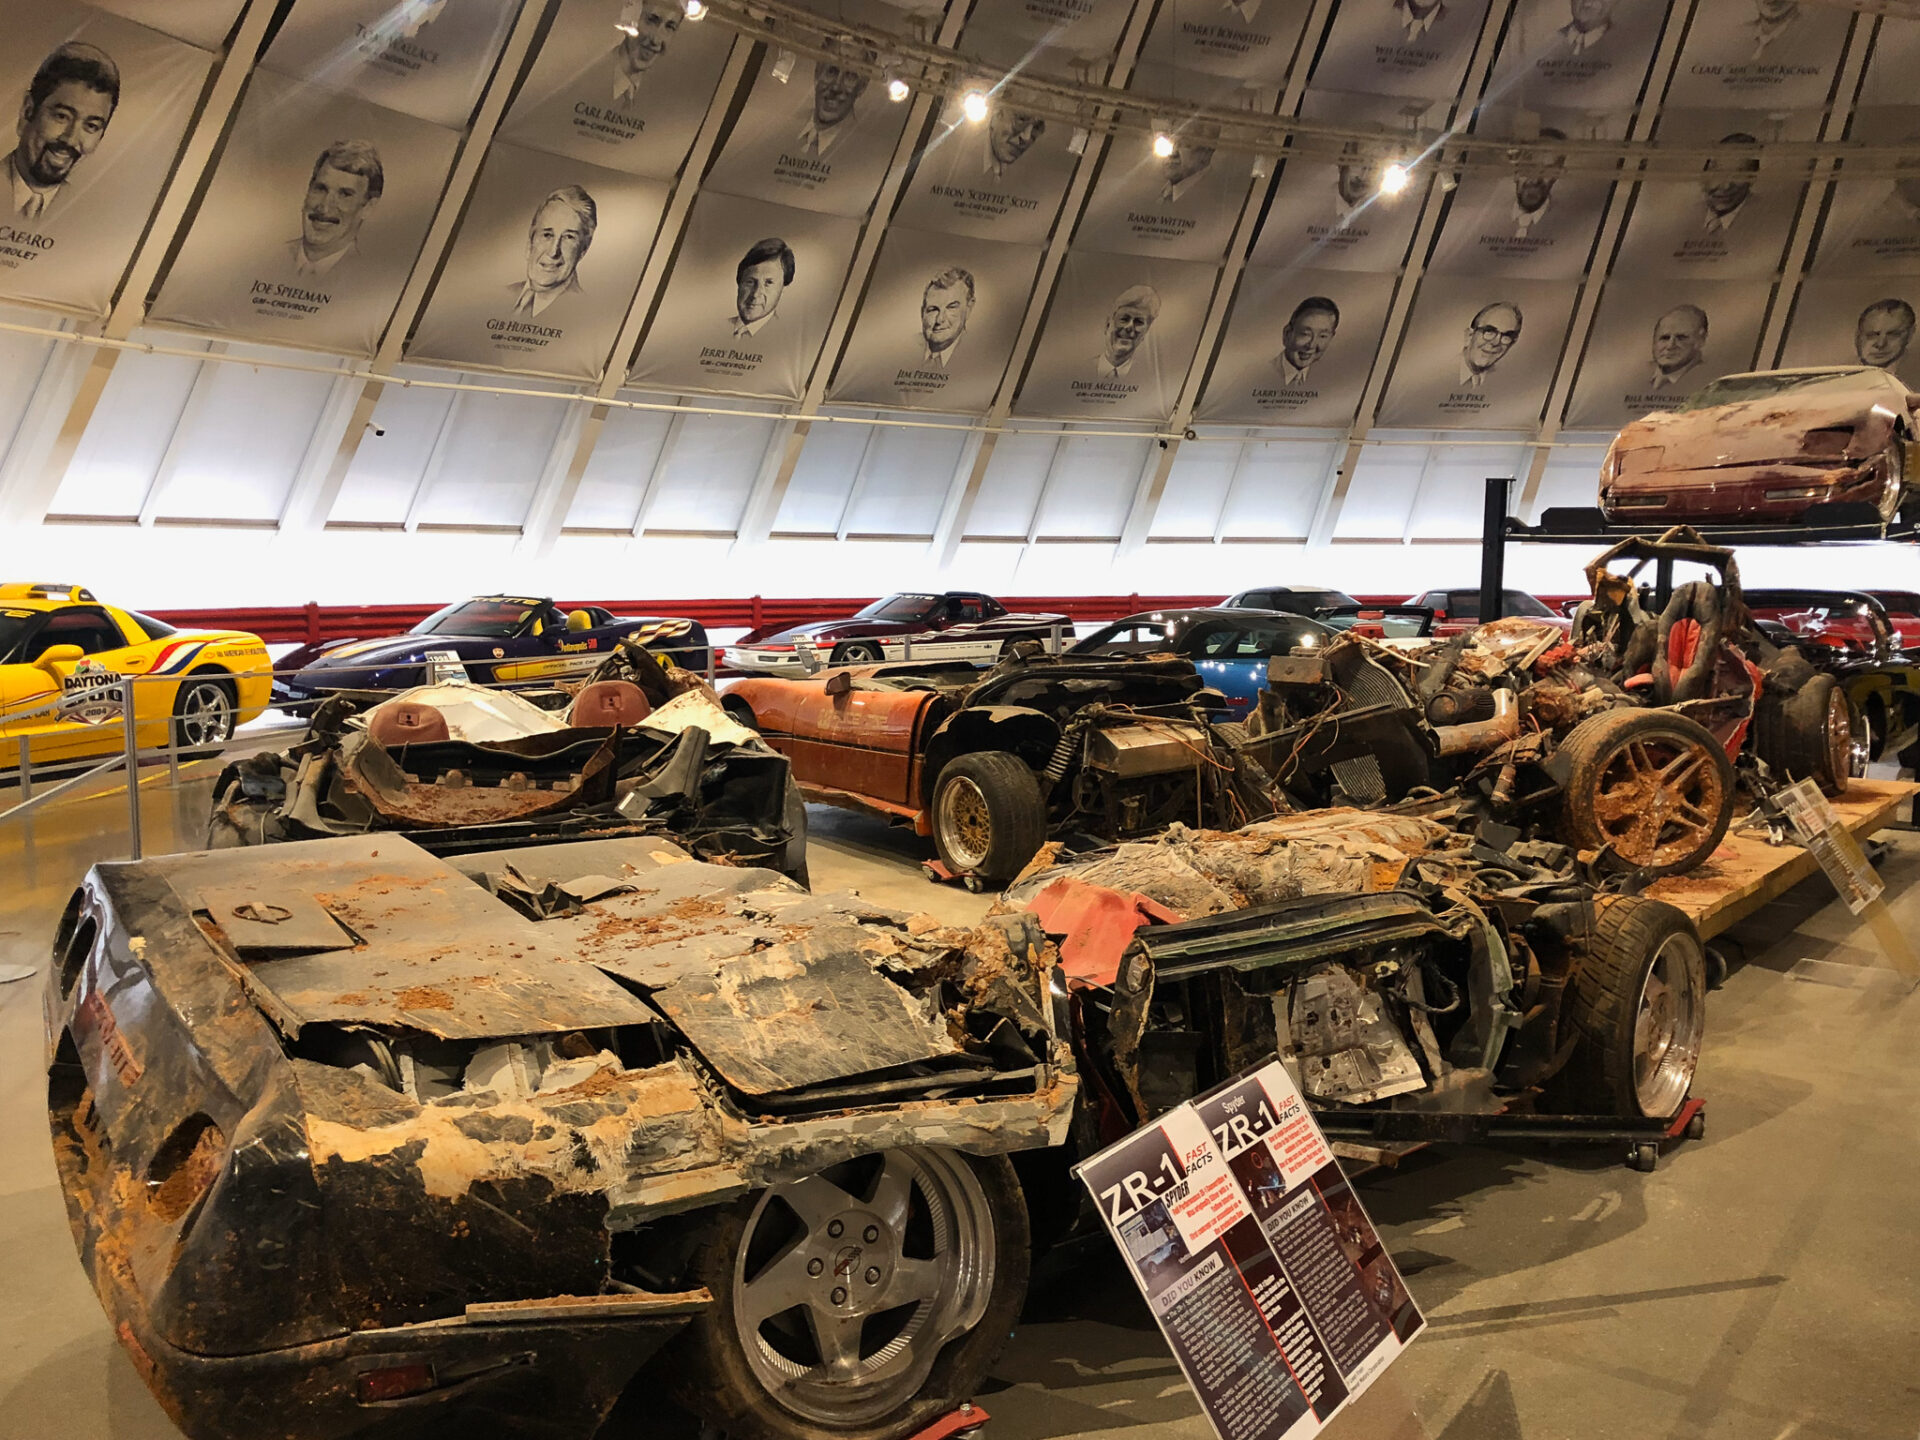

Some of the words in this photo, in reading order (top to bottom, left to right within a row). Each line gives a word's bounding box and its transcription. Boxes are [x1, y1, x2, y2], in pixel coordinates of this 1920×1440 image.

[574, 101, 601, 119] CARL
[0, 225, 55, 250] CAFARO
[250, 279, 274, 295] JOE
[273, 283, 332, 305] SPIELMAN
[251, 296, 320, 314] GM-CHEVROLET
[486, 319, 506, 331] GIB
[506, 320, 563, 339] HUFSTADER
[490, 333, 549, 347] GM-CHEVROLET
[700, 346, 726, 359] JERRY
[727, 349, 763, 363] PALMER
[914, 369, 949, 381] PERKINS
[1071, 380, 1094, 390] DAVE
[64, 674, 121, 690] DAYTONA
[1221, 1094, 1246, 1115] Spyder
[1278, 1094, 1295, 1111] FAST
[1279, 1103, 1301, 1122] FACTS
[1212, 1099, 1278, 1157] ZR-1
[1185, 1141, 1207, 1163] FAST
[1185, 1151, 1213, 1177] FACTS
[1100, 1152, 1183, 1227] ZR-1
[1164, 1180, 1190, 1208] SPYDER
[1266, 1217, 1280, 1232] DID
[1279, 1207, 1293, 1223] YOU
[1291, 1194, 1309, 1213] KNOW
[1161, 1290, 1177, 1308] DID
[1177, 1279, 1194, 1296] YOU
[1193, 1258, 1217, 1282] KNOW
